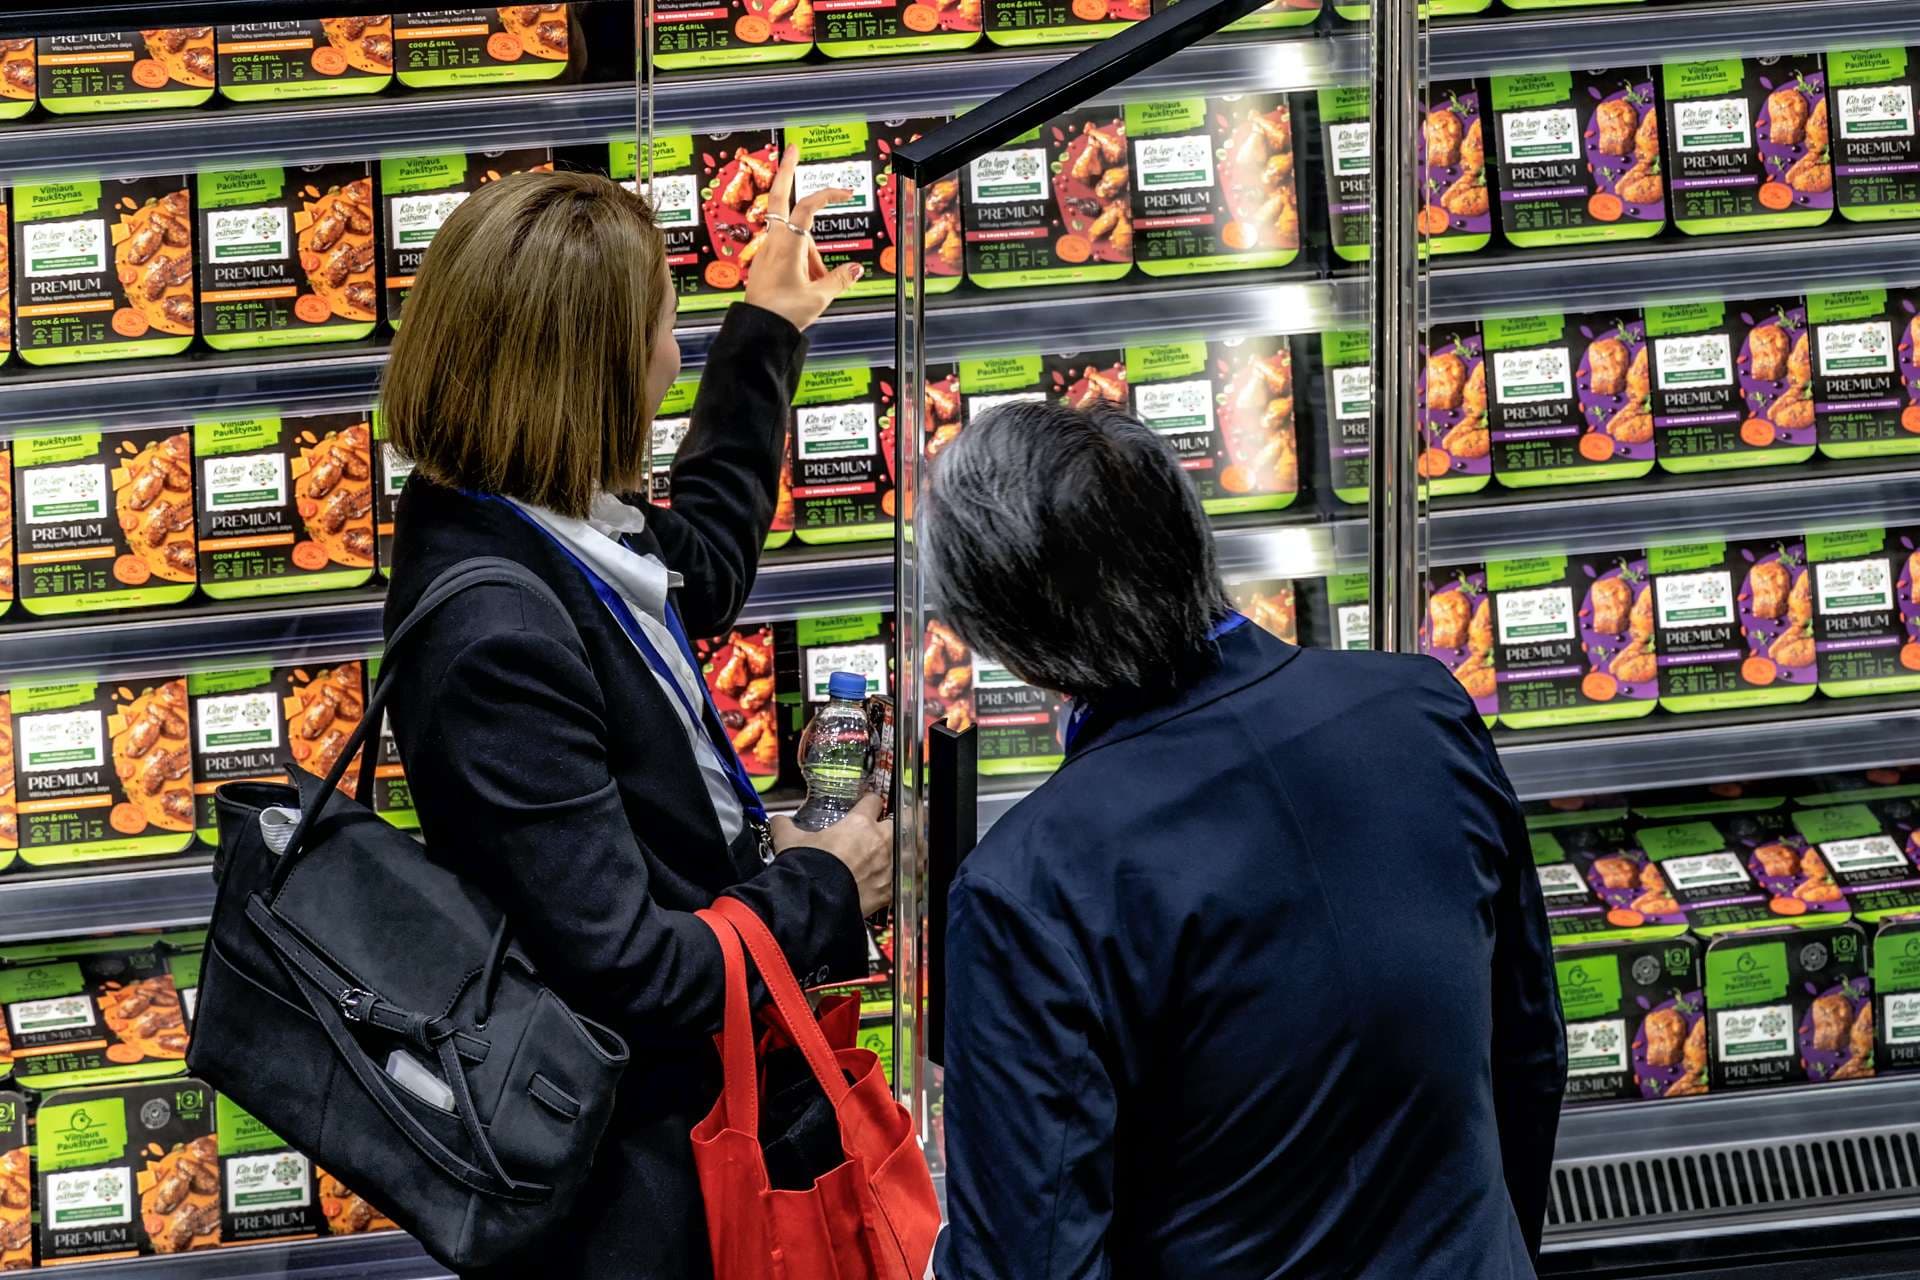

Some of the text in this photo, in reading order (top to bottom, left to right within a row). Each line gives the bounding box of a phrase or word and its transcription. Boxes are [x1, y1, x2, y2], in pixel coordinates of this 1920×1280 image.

[826, 12, 845, 20] COOK
[846, 11, 853, 19] &
[659, 22, 704, 32] COOK & GRILL
[252, 54, 259, 62] &
[260, 53, 280, 61] GRILL
[1850, 51, 1881, 60] Vilniaus
[72, 66, 79, 74] &
[1686, 64, 1718, 74] Vilniaus
[1514, 73, 1546, 84] Vilniaus
[1147, 99, 1180, 110] Vilniaus
[809, 125, 842, 136] Vilniaus
[1846, 140, 1911, 155] PREMIUM
[405, 156, 439, 167] Vilniaus
[1682, 152, 1747, 168] PREMIUM
[223, 171, 257, 181] Vilniaus
[1511, 163, 1576, 180] PREMIUM
[39, 183, 74, 194] Vilniaus
[1143, 191, 1210, 207] PREMIUM
[977, 204, 1044, 220] PREMIUM
[813, 216, 869, 233] REMIUM
[979, 243, 998, 251] COOK
[214, 263, 284, 280] PREMIUM
[30, 277, 100, 294] PREMIUM
[236, 302, 243, 310] &
[52, 316, 59, 325] &
[1826, 376, 1890, 392] PREMIUM
[1665, 389, 1729, 405] PREMIUM
[1503, 403, 1568, 420] PREMIUM
[212, 424, 261, 437] Paukštynas
[32, 434, 81, 447] Paukštynas
[804, 459, 871, 476] PREMIUM
[212, 510, 281, 528] PREMIUM
[32, 523, 102, 541] PREMIUM
[213, 552, 232, 560] COOK
[241, 549, 261, 557] GRILL
[33, 563, 82, 573] COOK & GRILL
[1825, 614, 1889, 630] PREMIUM
[1665, 627, 1730, 644] PREMIUM
[1506, 643, 1571, 660] PREMIUM
[980, 690, 1046, 705] PREMIUM
[205, 752, 274, 770] PREMIUM
[27, 771, 98, 789] PREMIUM
[1724, 1060, 1790, 1077] PREMIUM
[63, 1129, 99, 1142] Vilniaus
[234, 1210, 305, 1229] PREMIUM
[54, 1227, 126, 1247] PREMIUM
